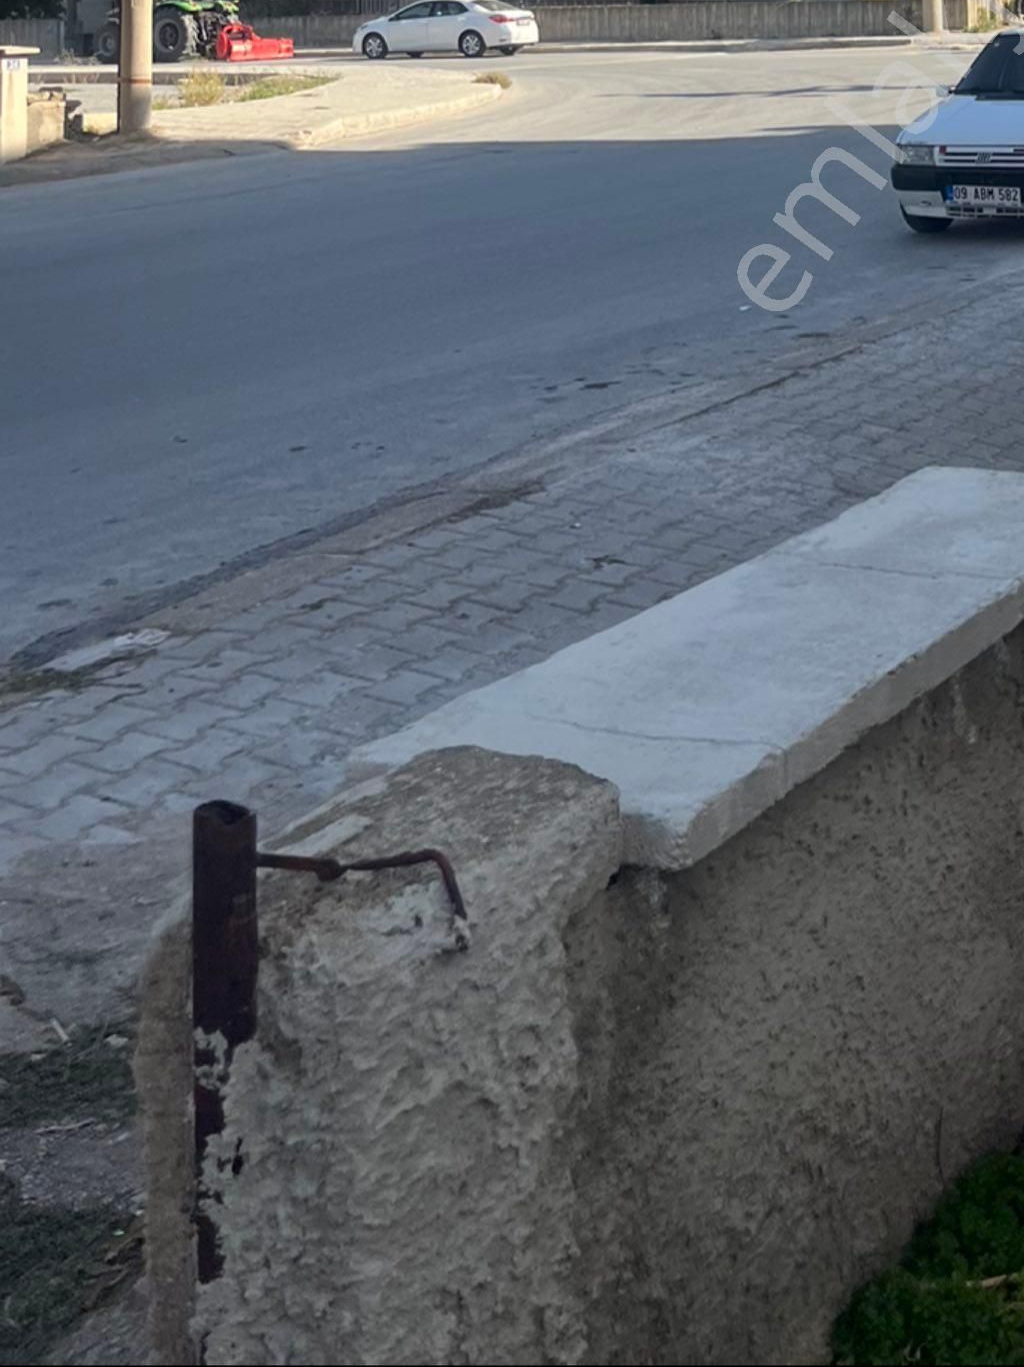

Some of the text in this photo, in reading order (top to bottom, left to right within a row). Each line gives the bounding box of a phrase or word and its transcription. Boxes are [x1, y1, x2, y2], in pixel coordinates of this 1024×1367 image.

[954, 186, 1019, 202] 09 ABM 582
